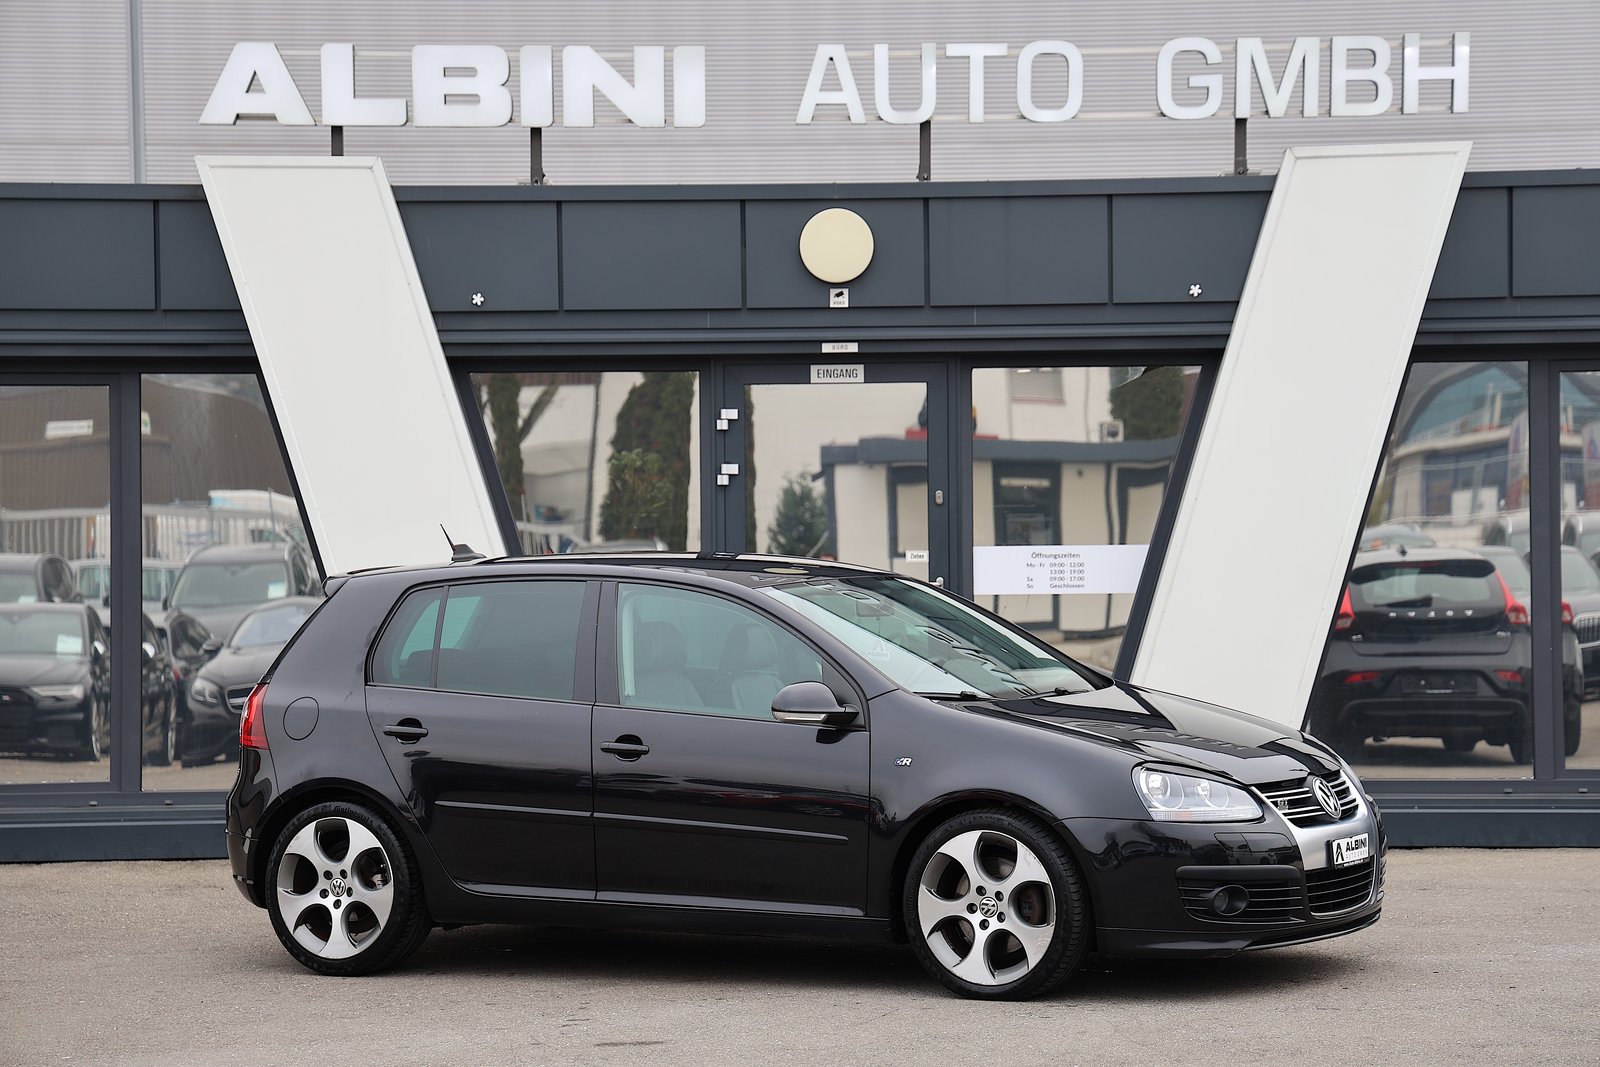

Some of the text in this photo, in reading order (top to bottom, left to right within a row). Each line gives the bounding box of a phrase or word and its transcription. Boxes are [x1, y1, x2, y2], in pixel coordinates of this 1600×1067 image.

[199, 31, 1471, 128] ALBINI AUTO GMBH
[816, 368, 859, 379] EINGANG
[1031, 551, 1081, 560] Öffnungszeiten
[1345, 837, 1368, 853] ALBINI
